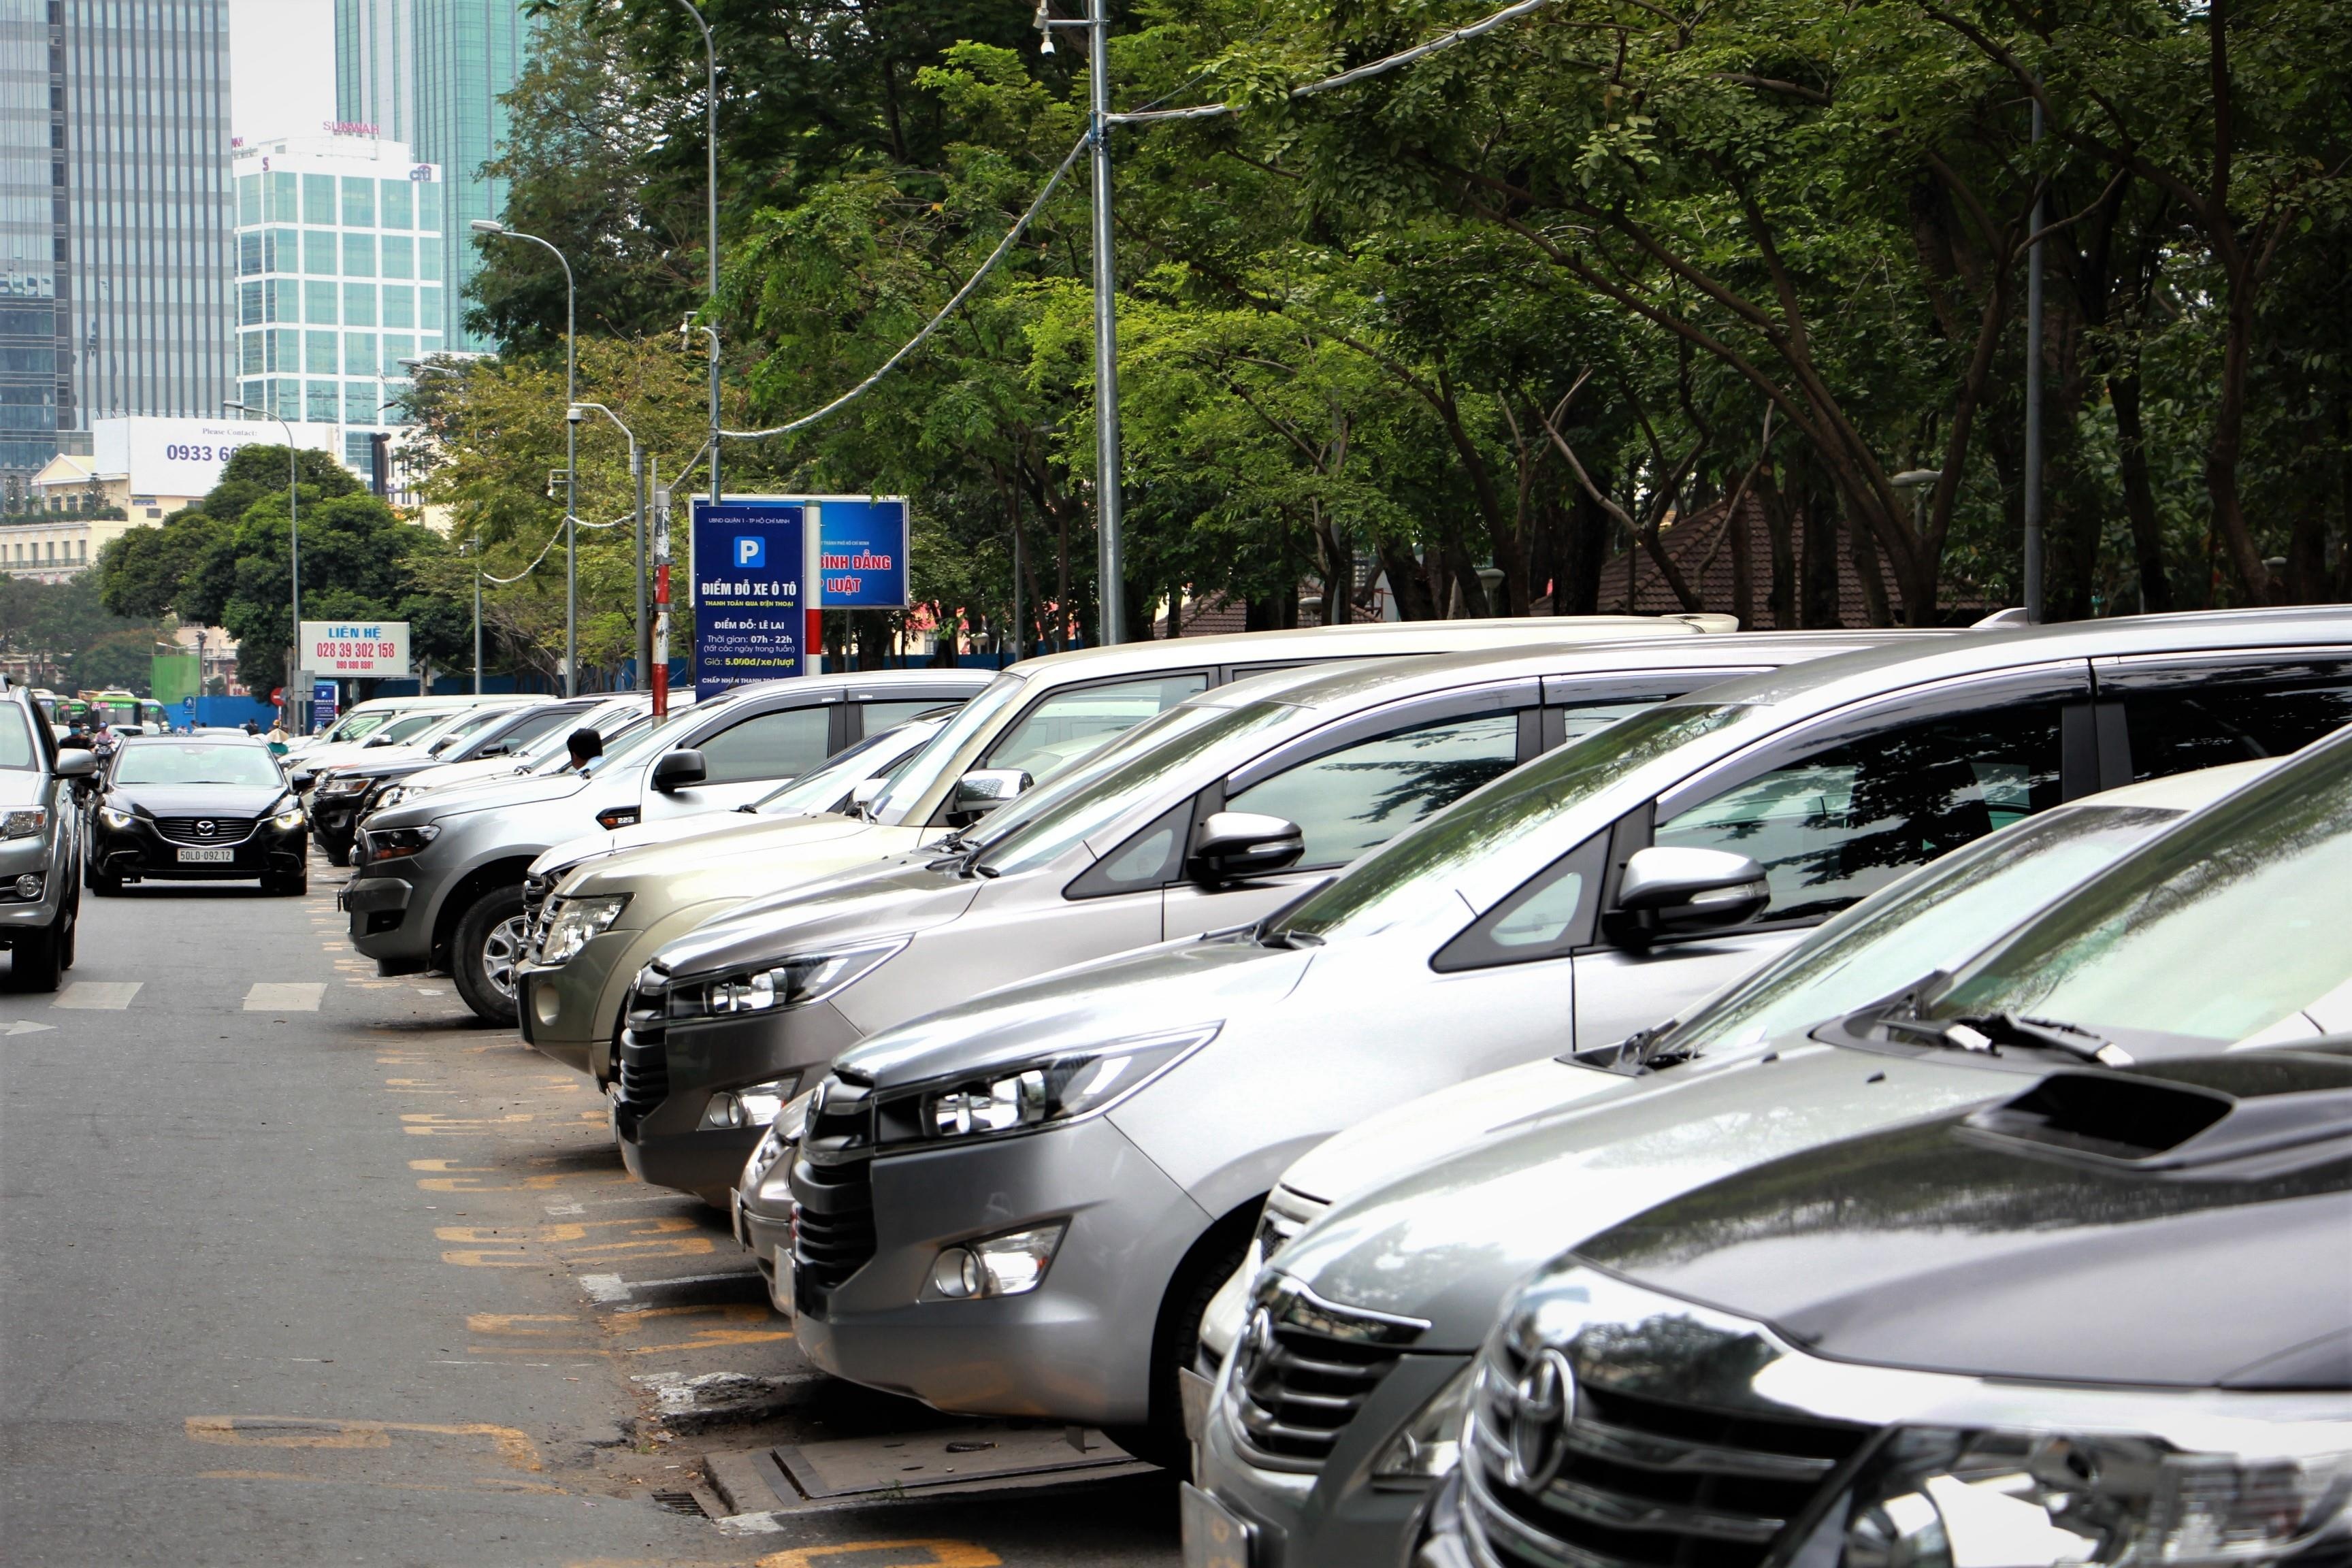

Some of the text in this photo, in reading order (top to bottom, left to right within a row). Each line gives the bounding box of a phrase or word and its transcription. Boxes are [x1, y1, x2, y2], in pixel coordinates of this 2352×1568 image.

[202, 427, 225, 436] Please
[167, 444, 212, 461] 0933
[740, 540, 759, 564] P
[852, 549, 892, 570] ĐẲNG
[702, 578, 797, 595] ĐIỂM ĐỖ XE Ô TÔ
[828, 575, 861, 595] LUẬT
[714, 617, 785, 630] ĐIỂM ĐỖ: LÊ LAI
[328, 626, 381, 640] LIÊN HỆ
[707, 635, 725, 643] Thời
[726, 636, 749, 644] gian:
[751, 636, 768, 644] 07h
[775, 636, 792, 644] 22h
[317, 642, 395, 657] 028 39 302 158
[704, 645, 717, 653] (tất
[336, 661, 347, 669] 090
[704, 657, 723, 666] Giá:
[180, 851, 231, 860] 50LD-092.12
